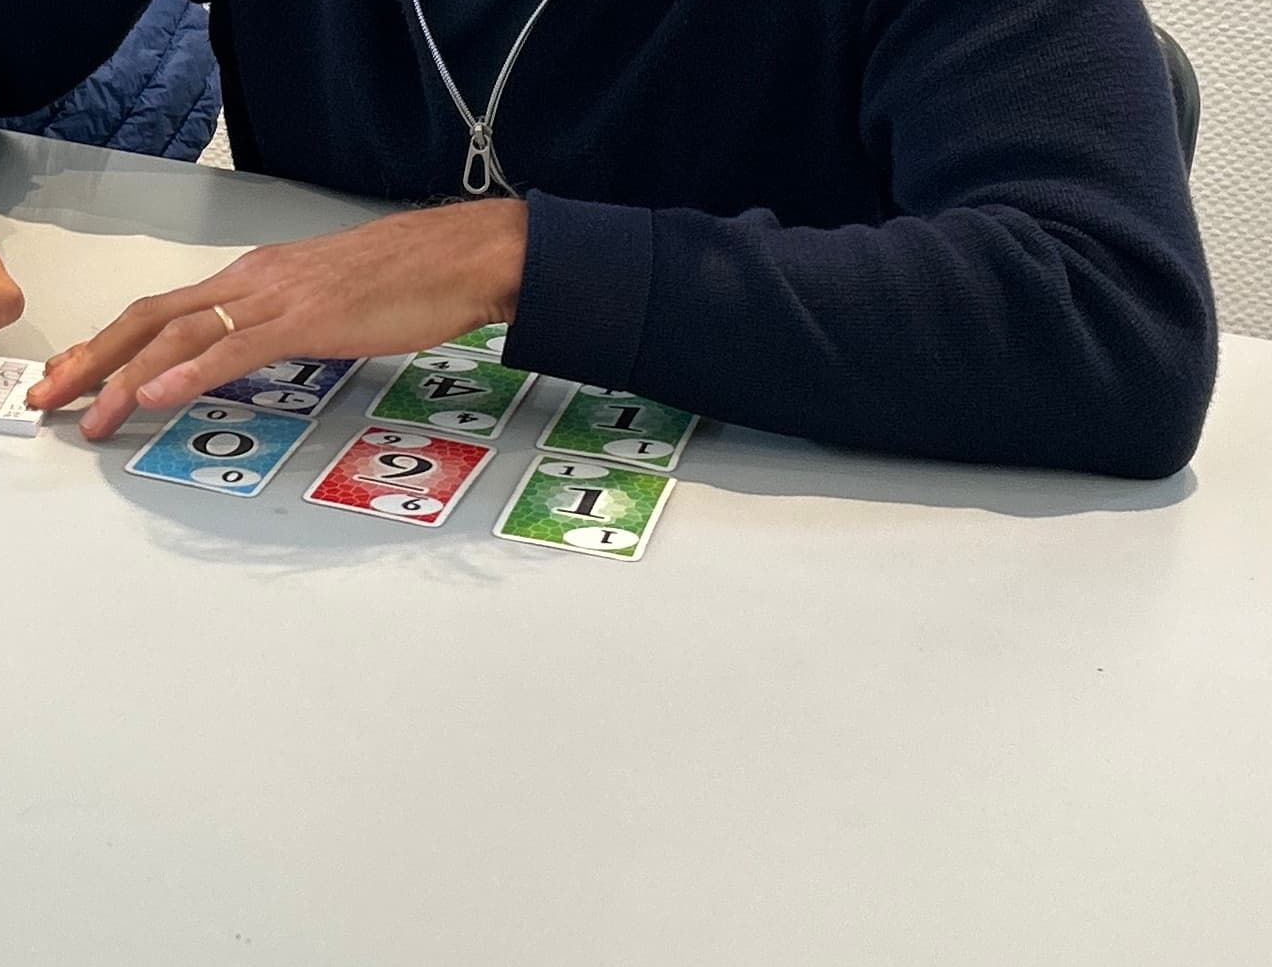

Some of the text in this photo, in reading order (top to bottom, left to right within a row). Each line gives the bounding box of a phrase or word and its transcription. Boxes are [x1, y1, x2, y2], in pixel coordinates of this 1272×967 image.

[430, 360, 450, 370] 4
[423, 375, 489, 399] 4
[207, 410, 227, 420] 0
[596, 405, 645, 432] 1
[192, 431, 254, 457] 0
[637, 440, 653, 454] 1
[222, 470, 243, 482] 0
[559, 465, 575, 476] 1
[556, 487, 604, 519] 1
[600, 530, 617, 544] 1
